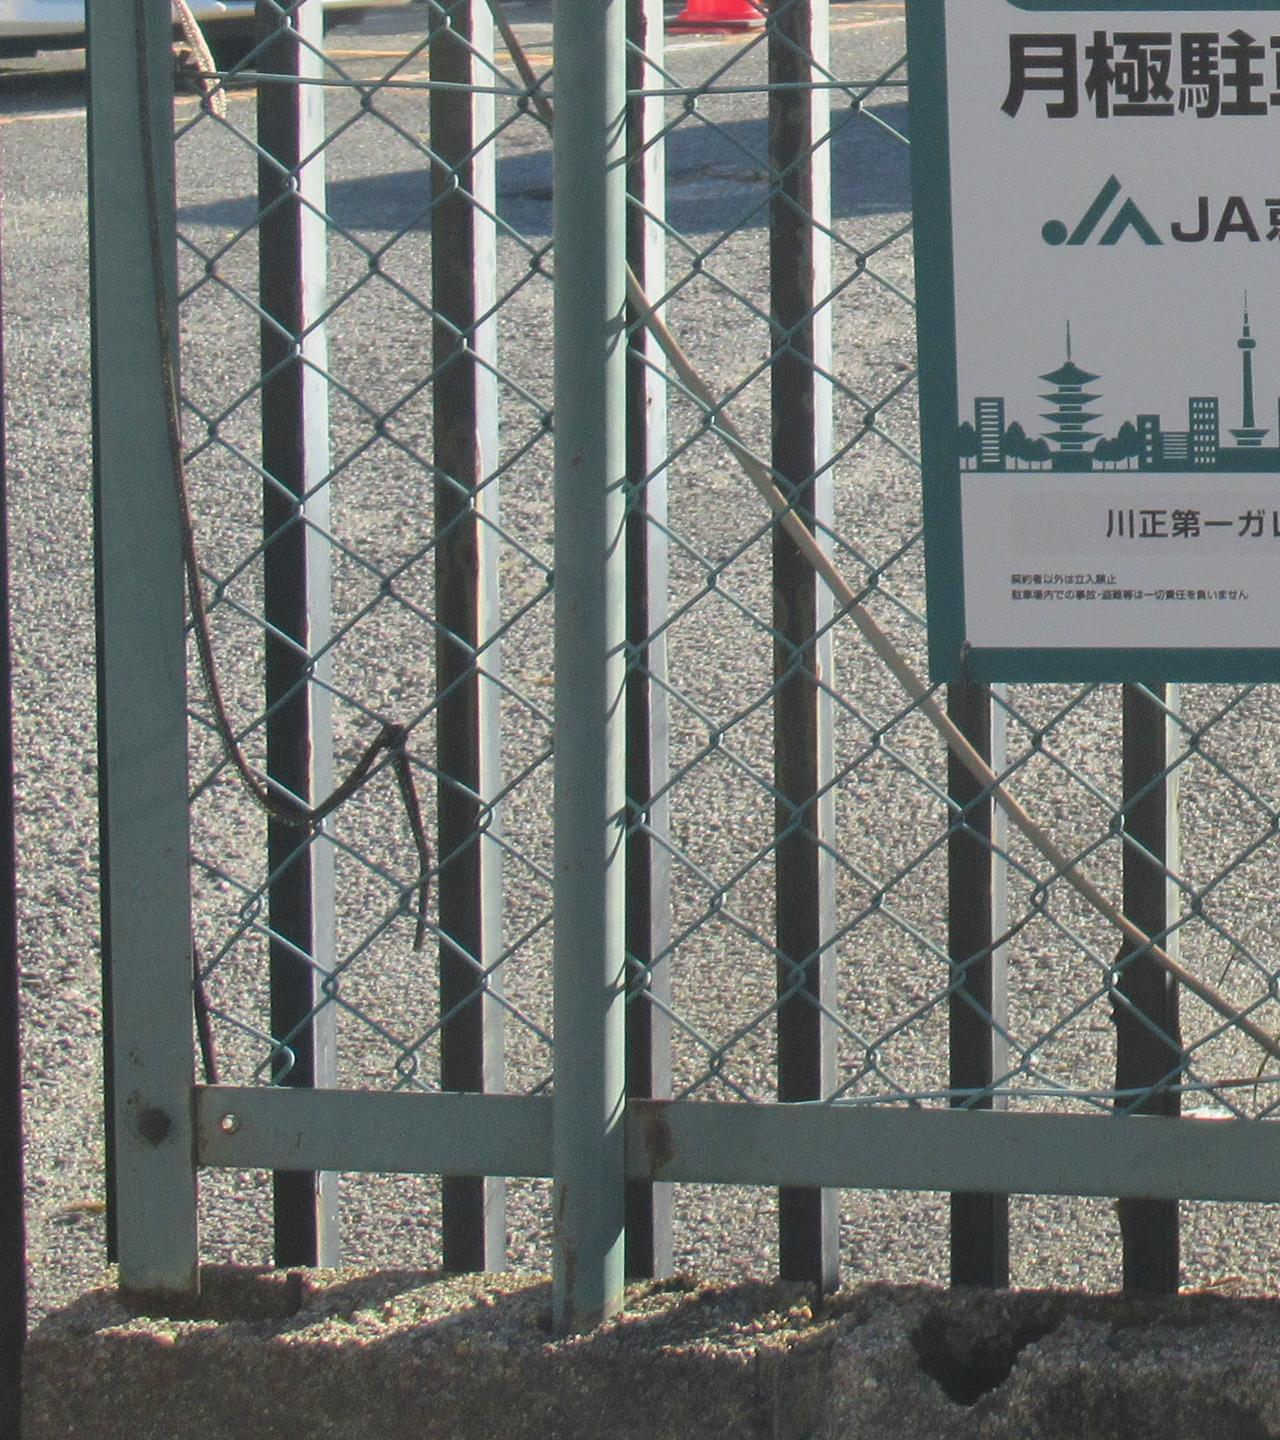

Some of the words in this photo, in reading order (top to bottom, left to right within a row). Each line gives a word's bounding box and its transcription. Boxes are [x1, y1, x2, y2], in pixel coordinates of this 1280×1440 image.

[1011, 573, 1116, 585] 契約者以外は立入禁止
